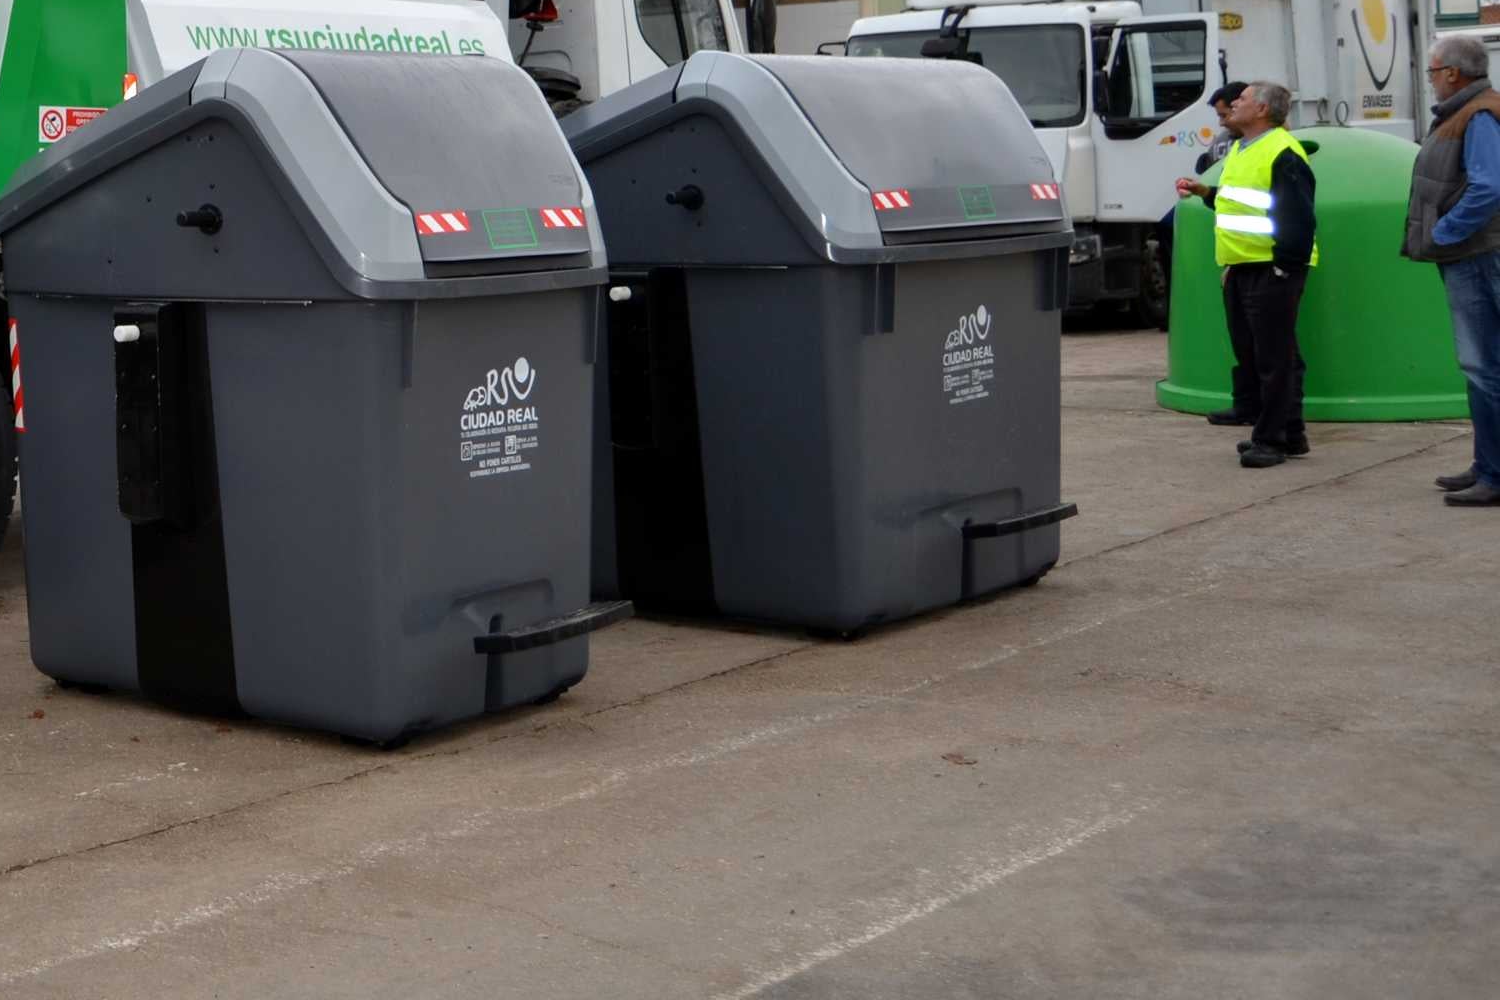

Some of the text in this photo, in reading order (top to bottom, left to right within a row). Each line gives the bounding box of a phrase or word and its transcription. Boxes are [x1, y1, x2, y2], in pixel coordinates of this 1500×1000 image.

[943, 349, 972, 366] CIUDAD
[973, 344, 994, 360] REAL
[460, 406, 539, 430] CIUDAD REAL
